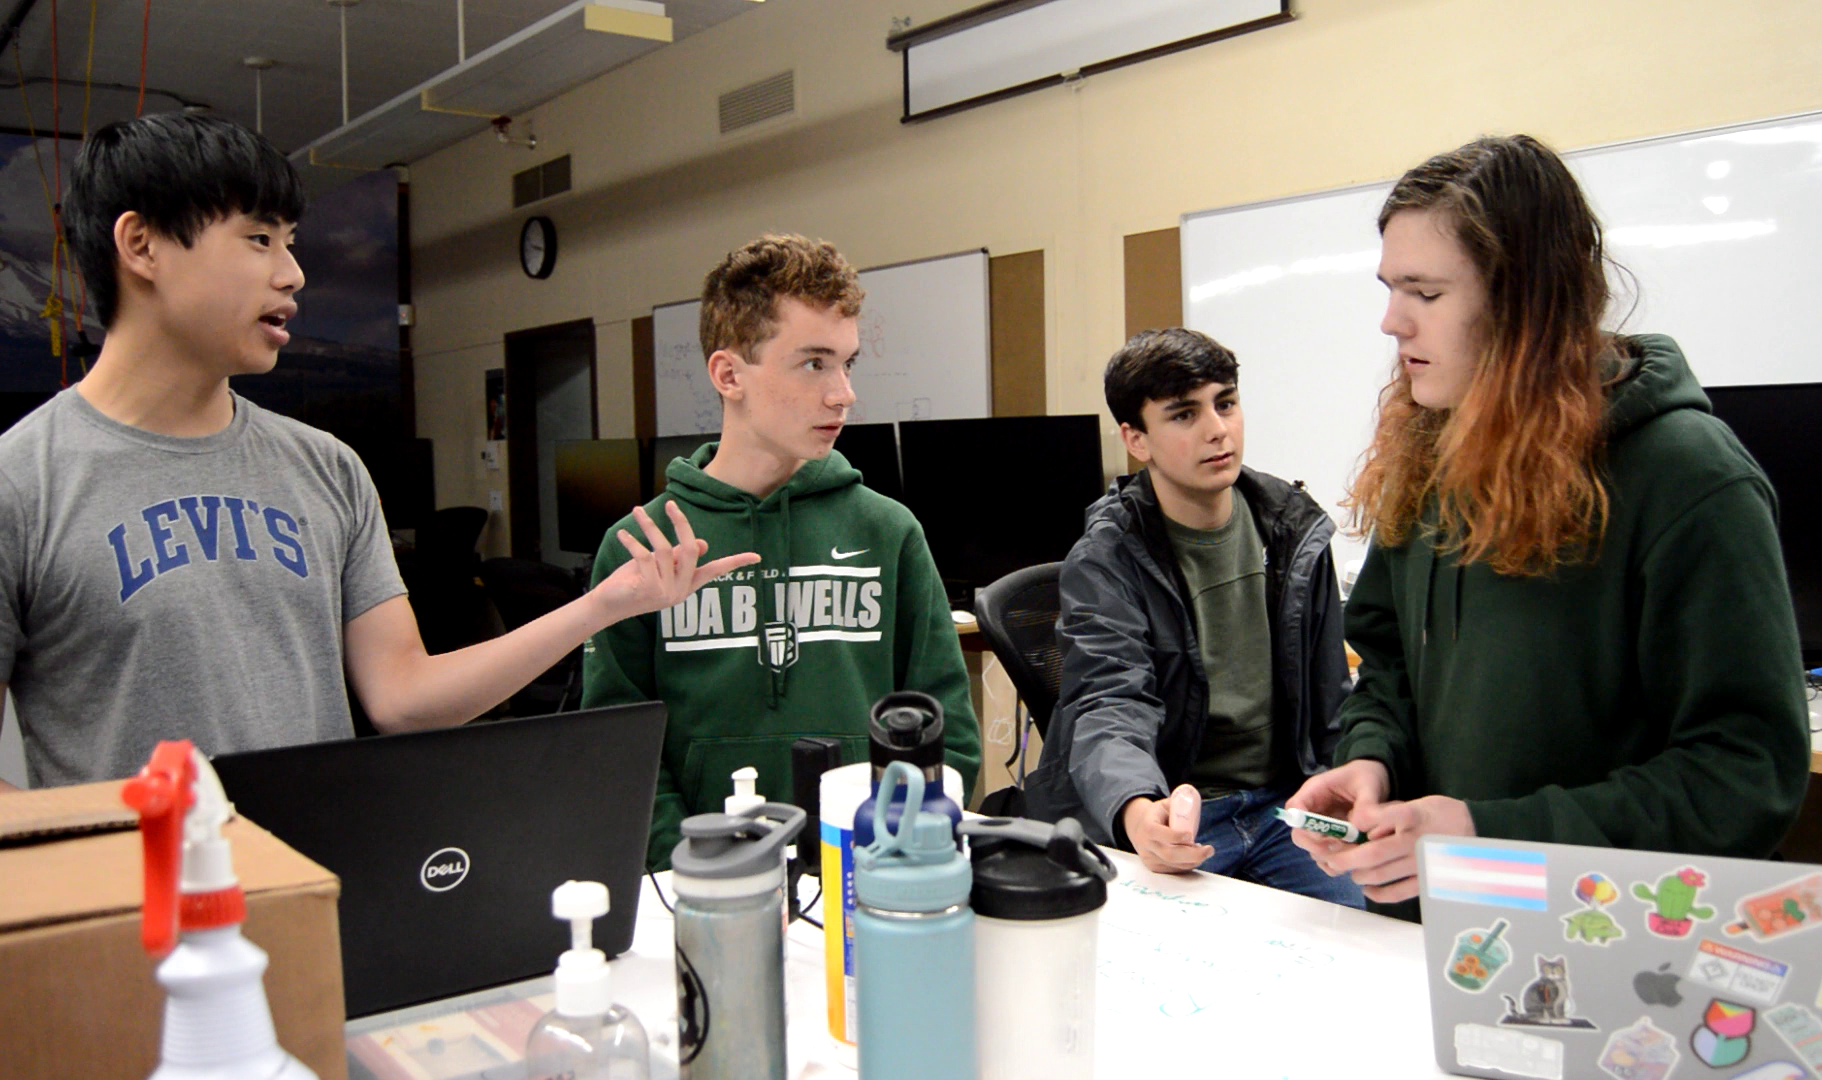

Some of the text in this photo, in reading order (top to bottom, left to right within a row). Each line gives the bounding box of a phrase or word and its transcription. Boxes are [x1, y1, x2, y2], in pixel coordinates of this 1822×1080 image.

[107, 495, 308, 603] LEVI'S
[736, 571, 745, 581] &
[747, 568, 779, 580] FLD
[661, 587, 724, 638] IDA
[774, 579, 883, 628] WELLS
[427, 861, 465, 879] DELL
